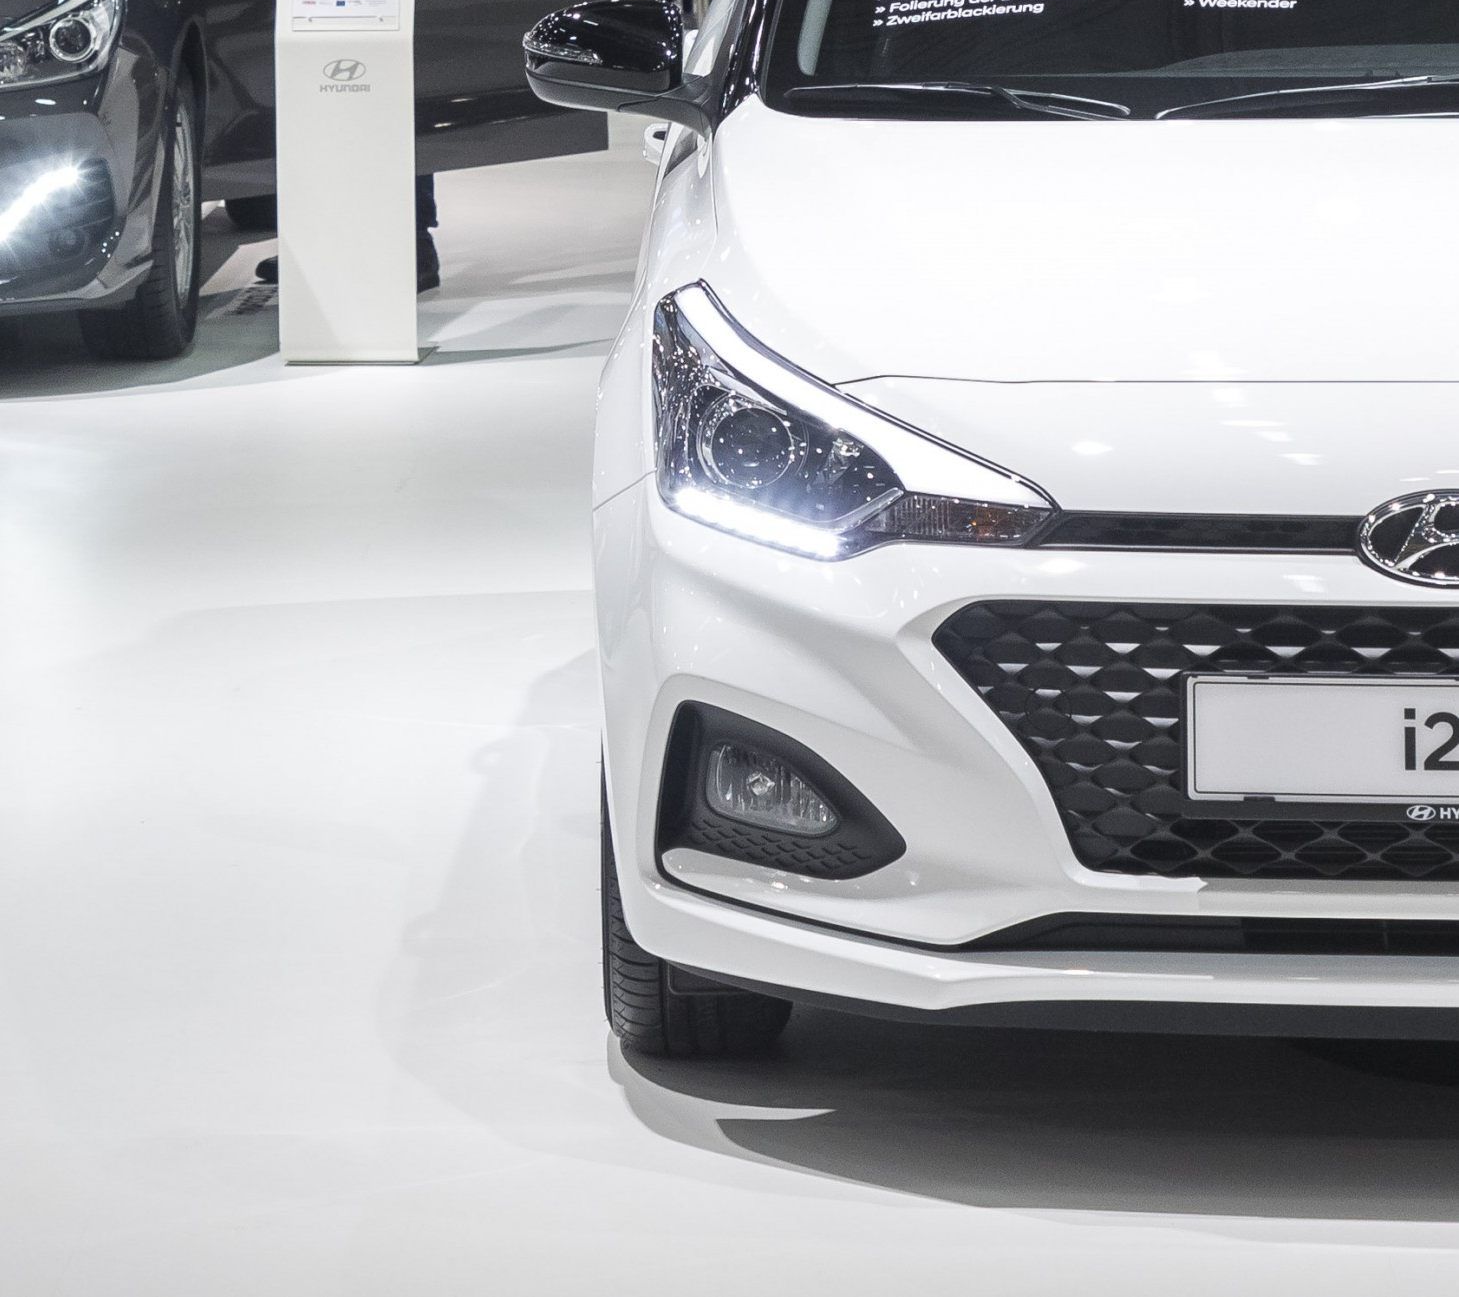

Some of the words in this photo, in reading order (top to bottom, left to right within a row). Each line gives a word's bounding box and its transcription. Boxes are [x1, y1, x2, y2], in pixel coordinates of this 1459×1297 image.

[885, 3, 1045, 27] Zweifarblackierung
[319, 84, 371, 93] HYUNDAI
[1404, 707, 1459, 771] i2
